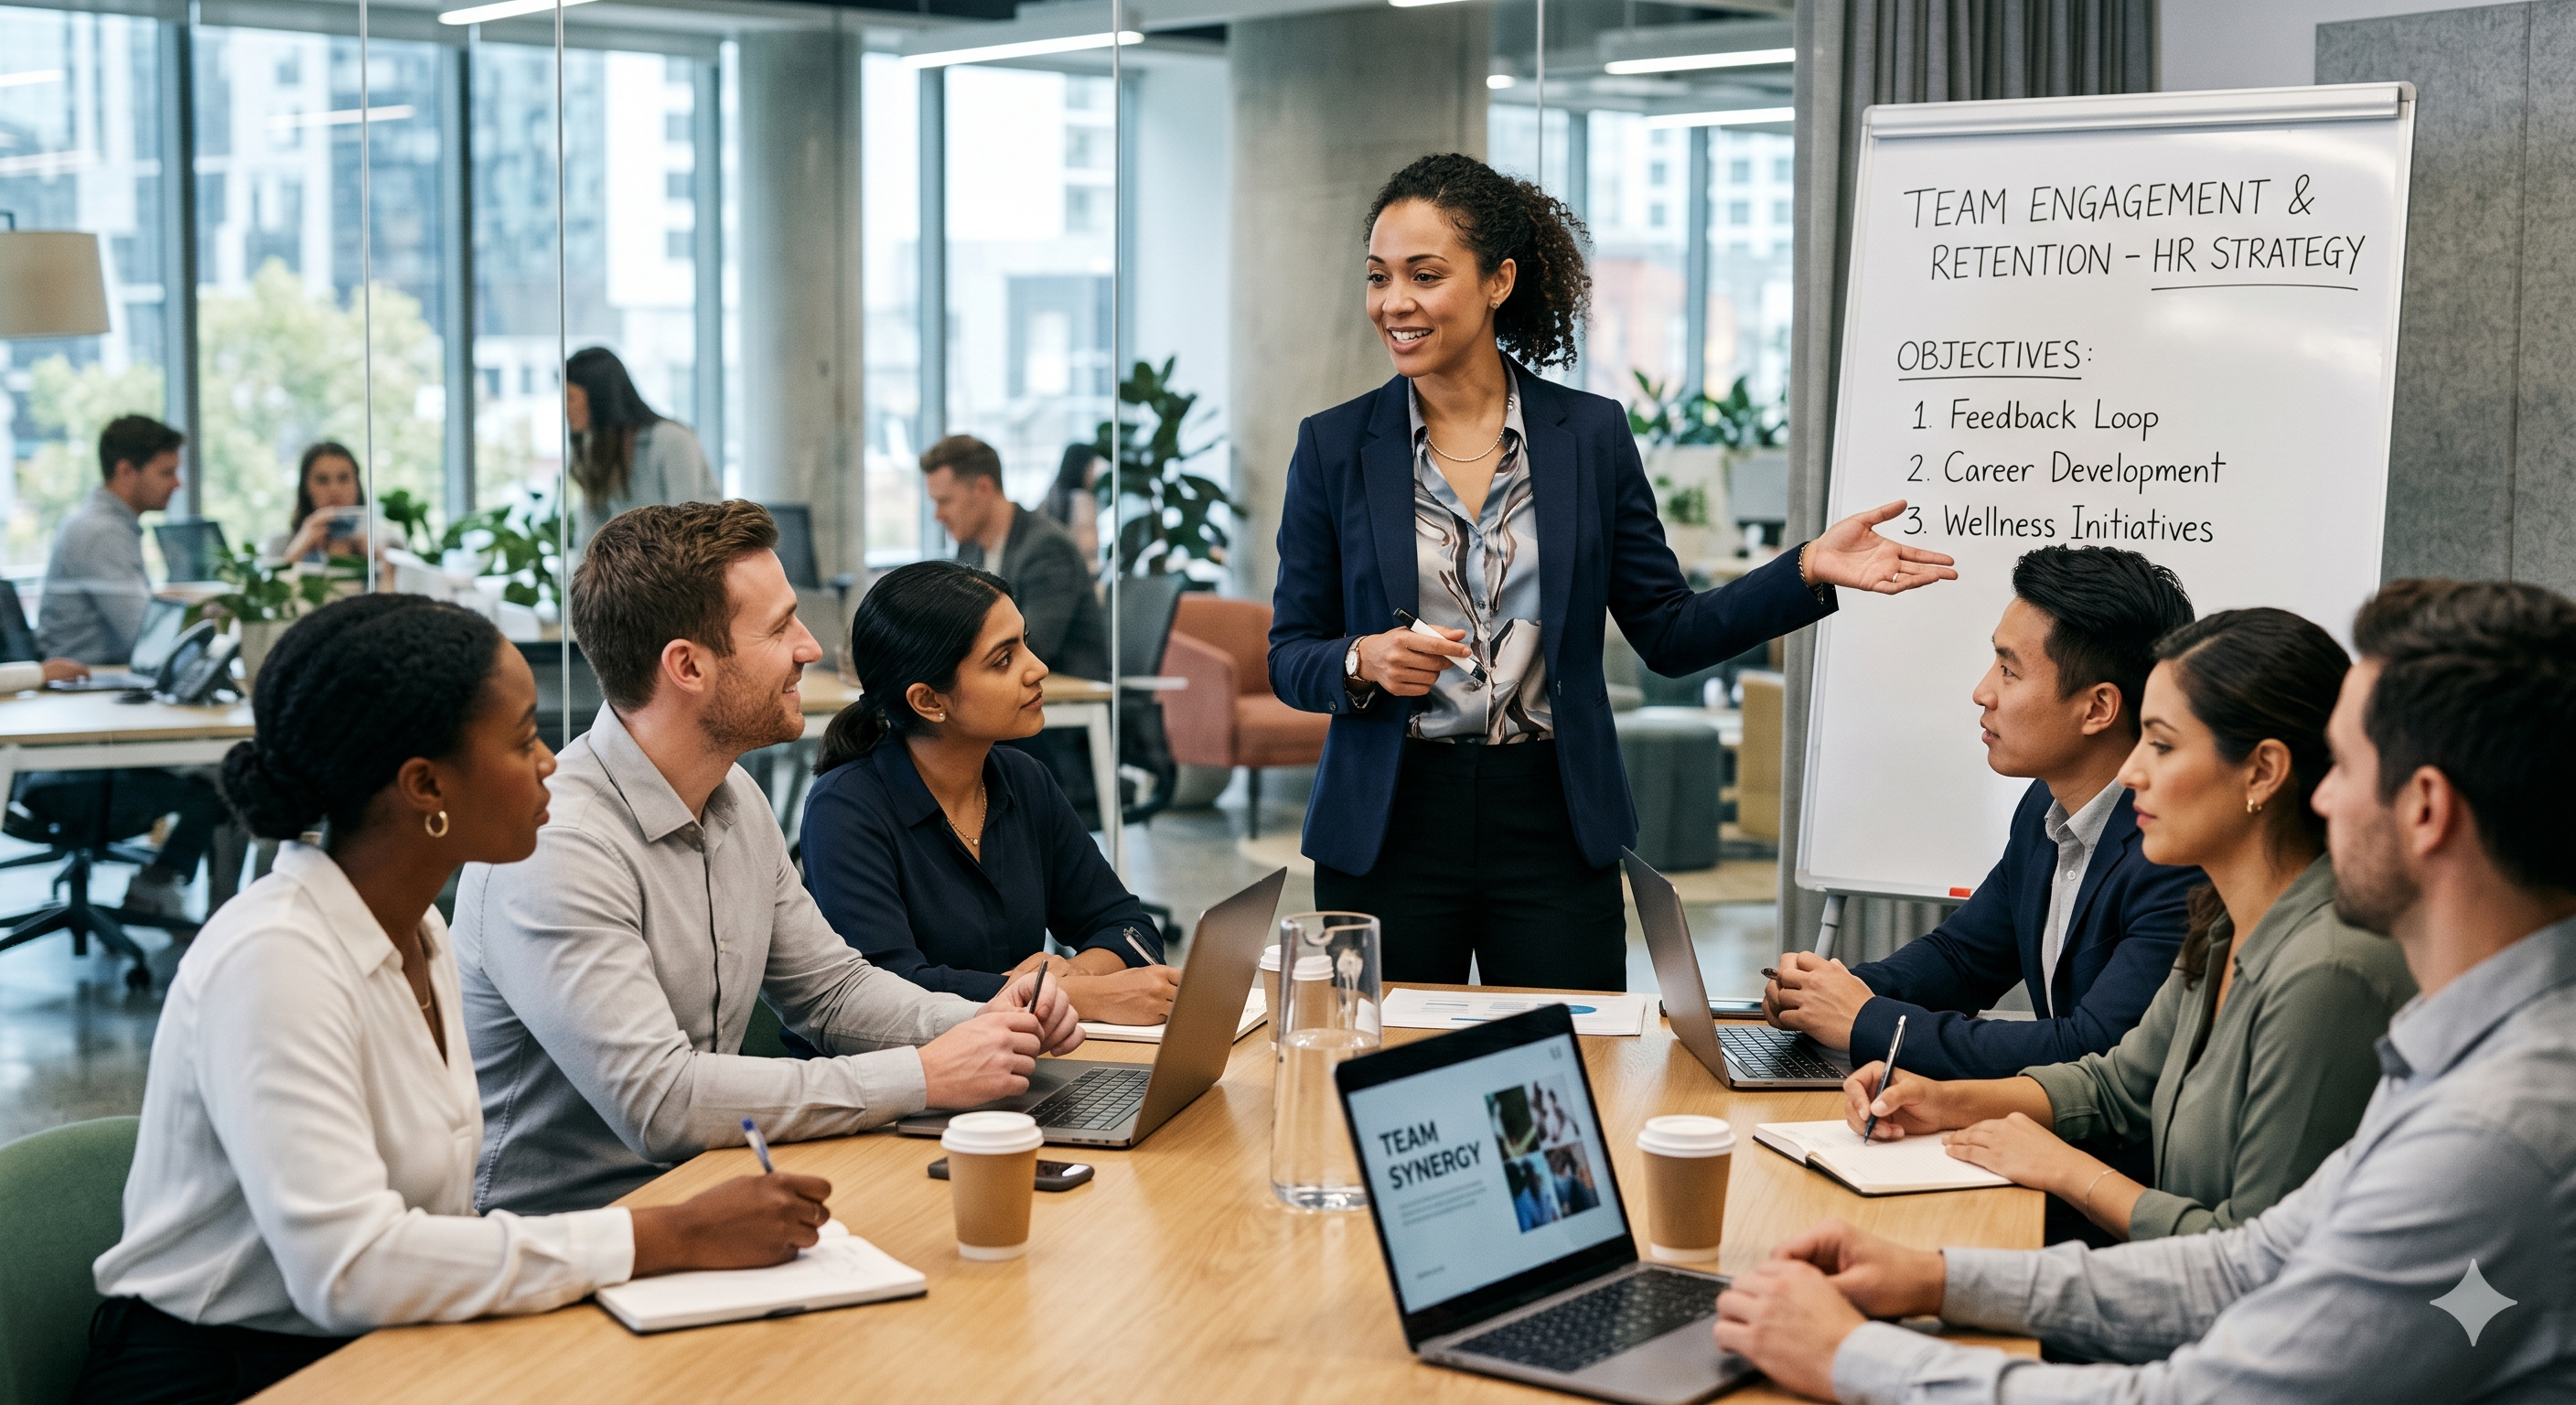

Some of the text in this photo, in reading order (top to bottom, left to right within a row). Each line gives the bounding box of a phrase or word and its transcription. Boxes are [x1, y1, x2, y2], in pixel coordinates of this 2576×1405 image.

[1904, 174, 2315, 228] TEAM ENGAGEMENT &
[1931, 242, 2111, 280] RETENTION
[2153, 236, 2196, 273] HR
[2210, 235, 2367, 275] STRATEGY
[1897, 339, 2093, 371] OBJECTIVES:
[1912, 398, 2159, 442] 1. Feedback Loop
[1906, 450, 2227, 495] 2. Career Development
[1903, 504, 2214, 543] 3. Wellness Initiatives
[1379, 1120, 1440, 1156] TEAM
[1387, 1141, 1482, 1190] SYNERGY
